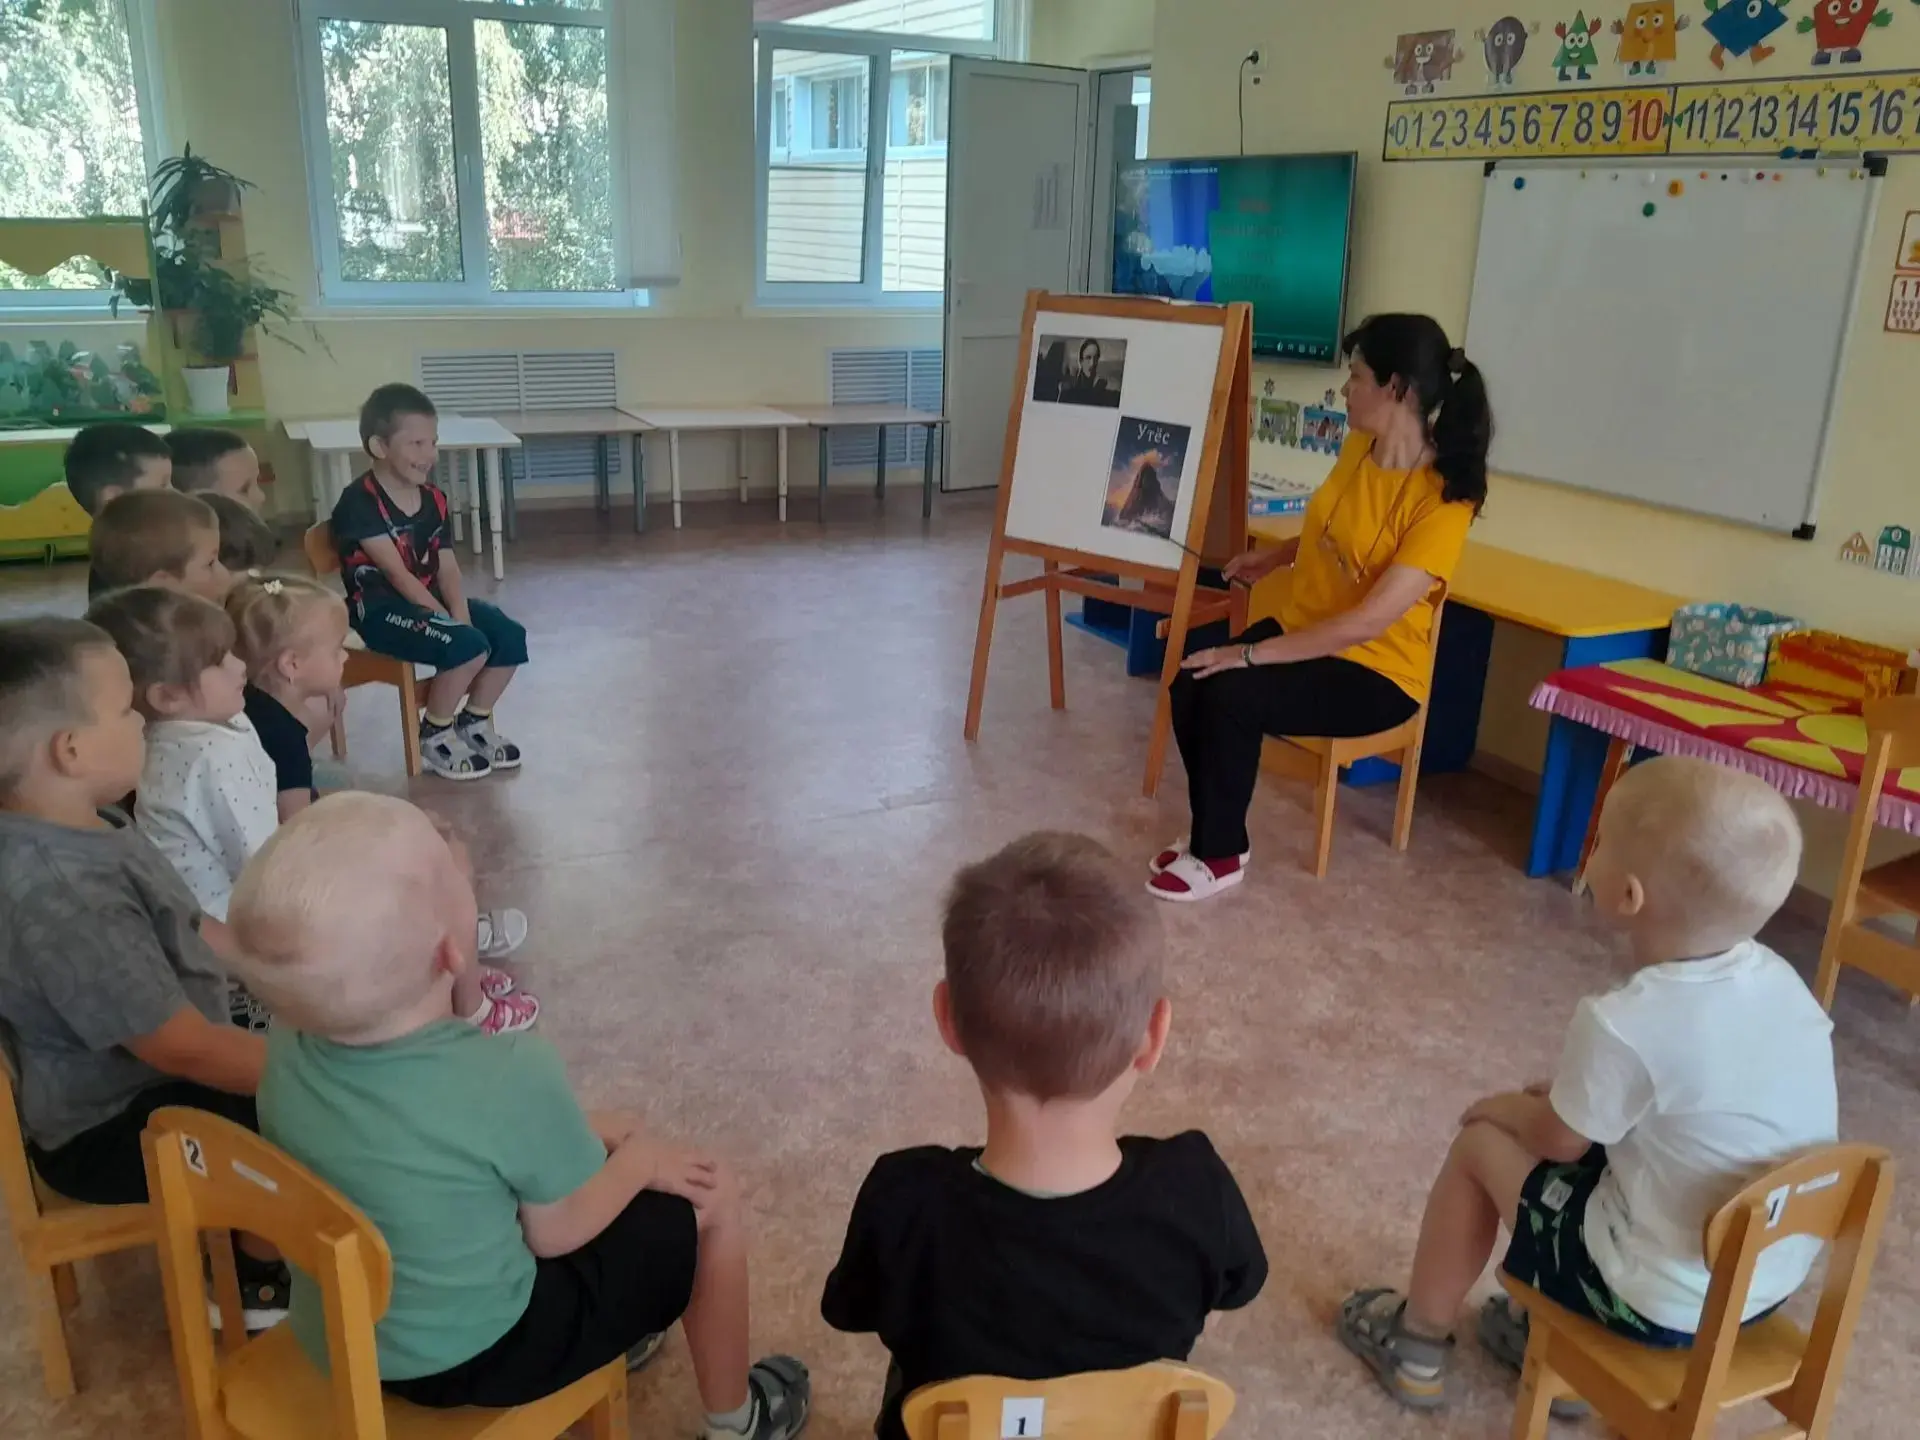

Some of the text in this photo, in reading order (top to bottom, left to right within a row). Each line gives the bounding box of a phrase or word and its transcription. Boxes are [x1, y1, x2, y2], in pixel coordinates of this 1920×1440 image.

[1395, 98, 1663, 148] 0 1 2 3 4 5 6 7 8 9 10
[1683, 98, 1709, 140] 11
[1714, 98, 1744, 139] 12
[1749, 95, 1779, 139] 13
[1786, 92, 1820, 137] 14
[1827, 91, 1862, 137] 15
[1869, 89, 1906, 136] 16
[1137, 423, 1170, 445] Утёс
[185, 1139, 204, 1170] 2
[1016, 1416, 1026, 1436] 1
